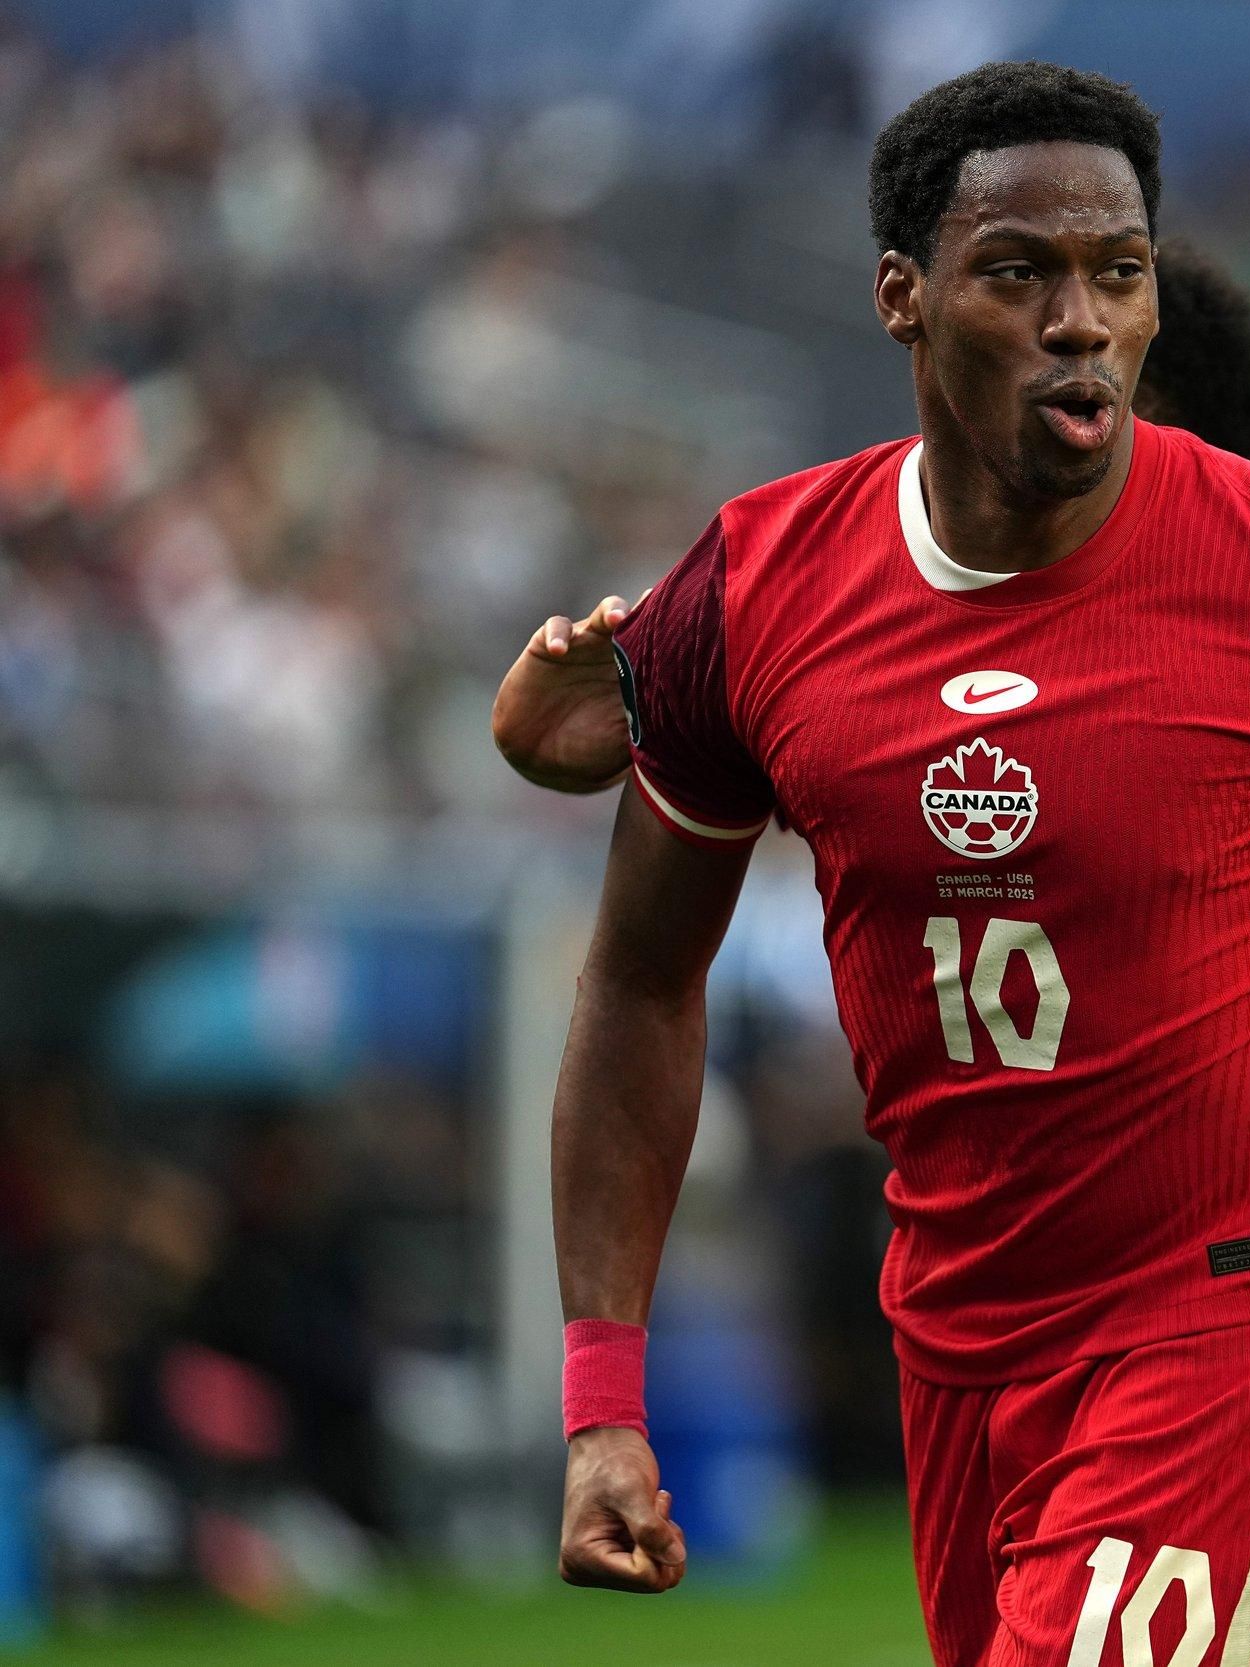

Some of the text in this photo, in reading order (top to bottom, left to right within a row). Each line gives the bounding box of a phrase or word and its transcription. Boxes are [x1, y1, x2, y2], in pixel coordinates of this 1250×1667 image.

[925, 792, 1032, 812] CANADA
[936, 874, 991, 885] CANADA
[1006, 873, 1034, 885] USA
[939, 887, 1035, 900] 23 MARCH 2025
[923, 916, 1071, 1071] 10
[1067, 1536, 1216, 1667] 10
